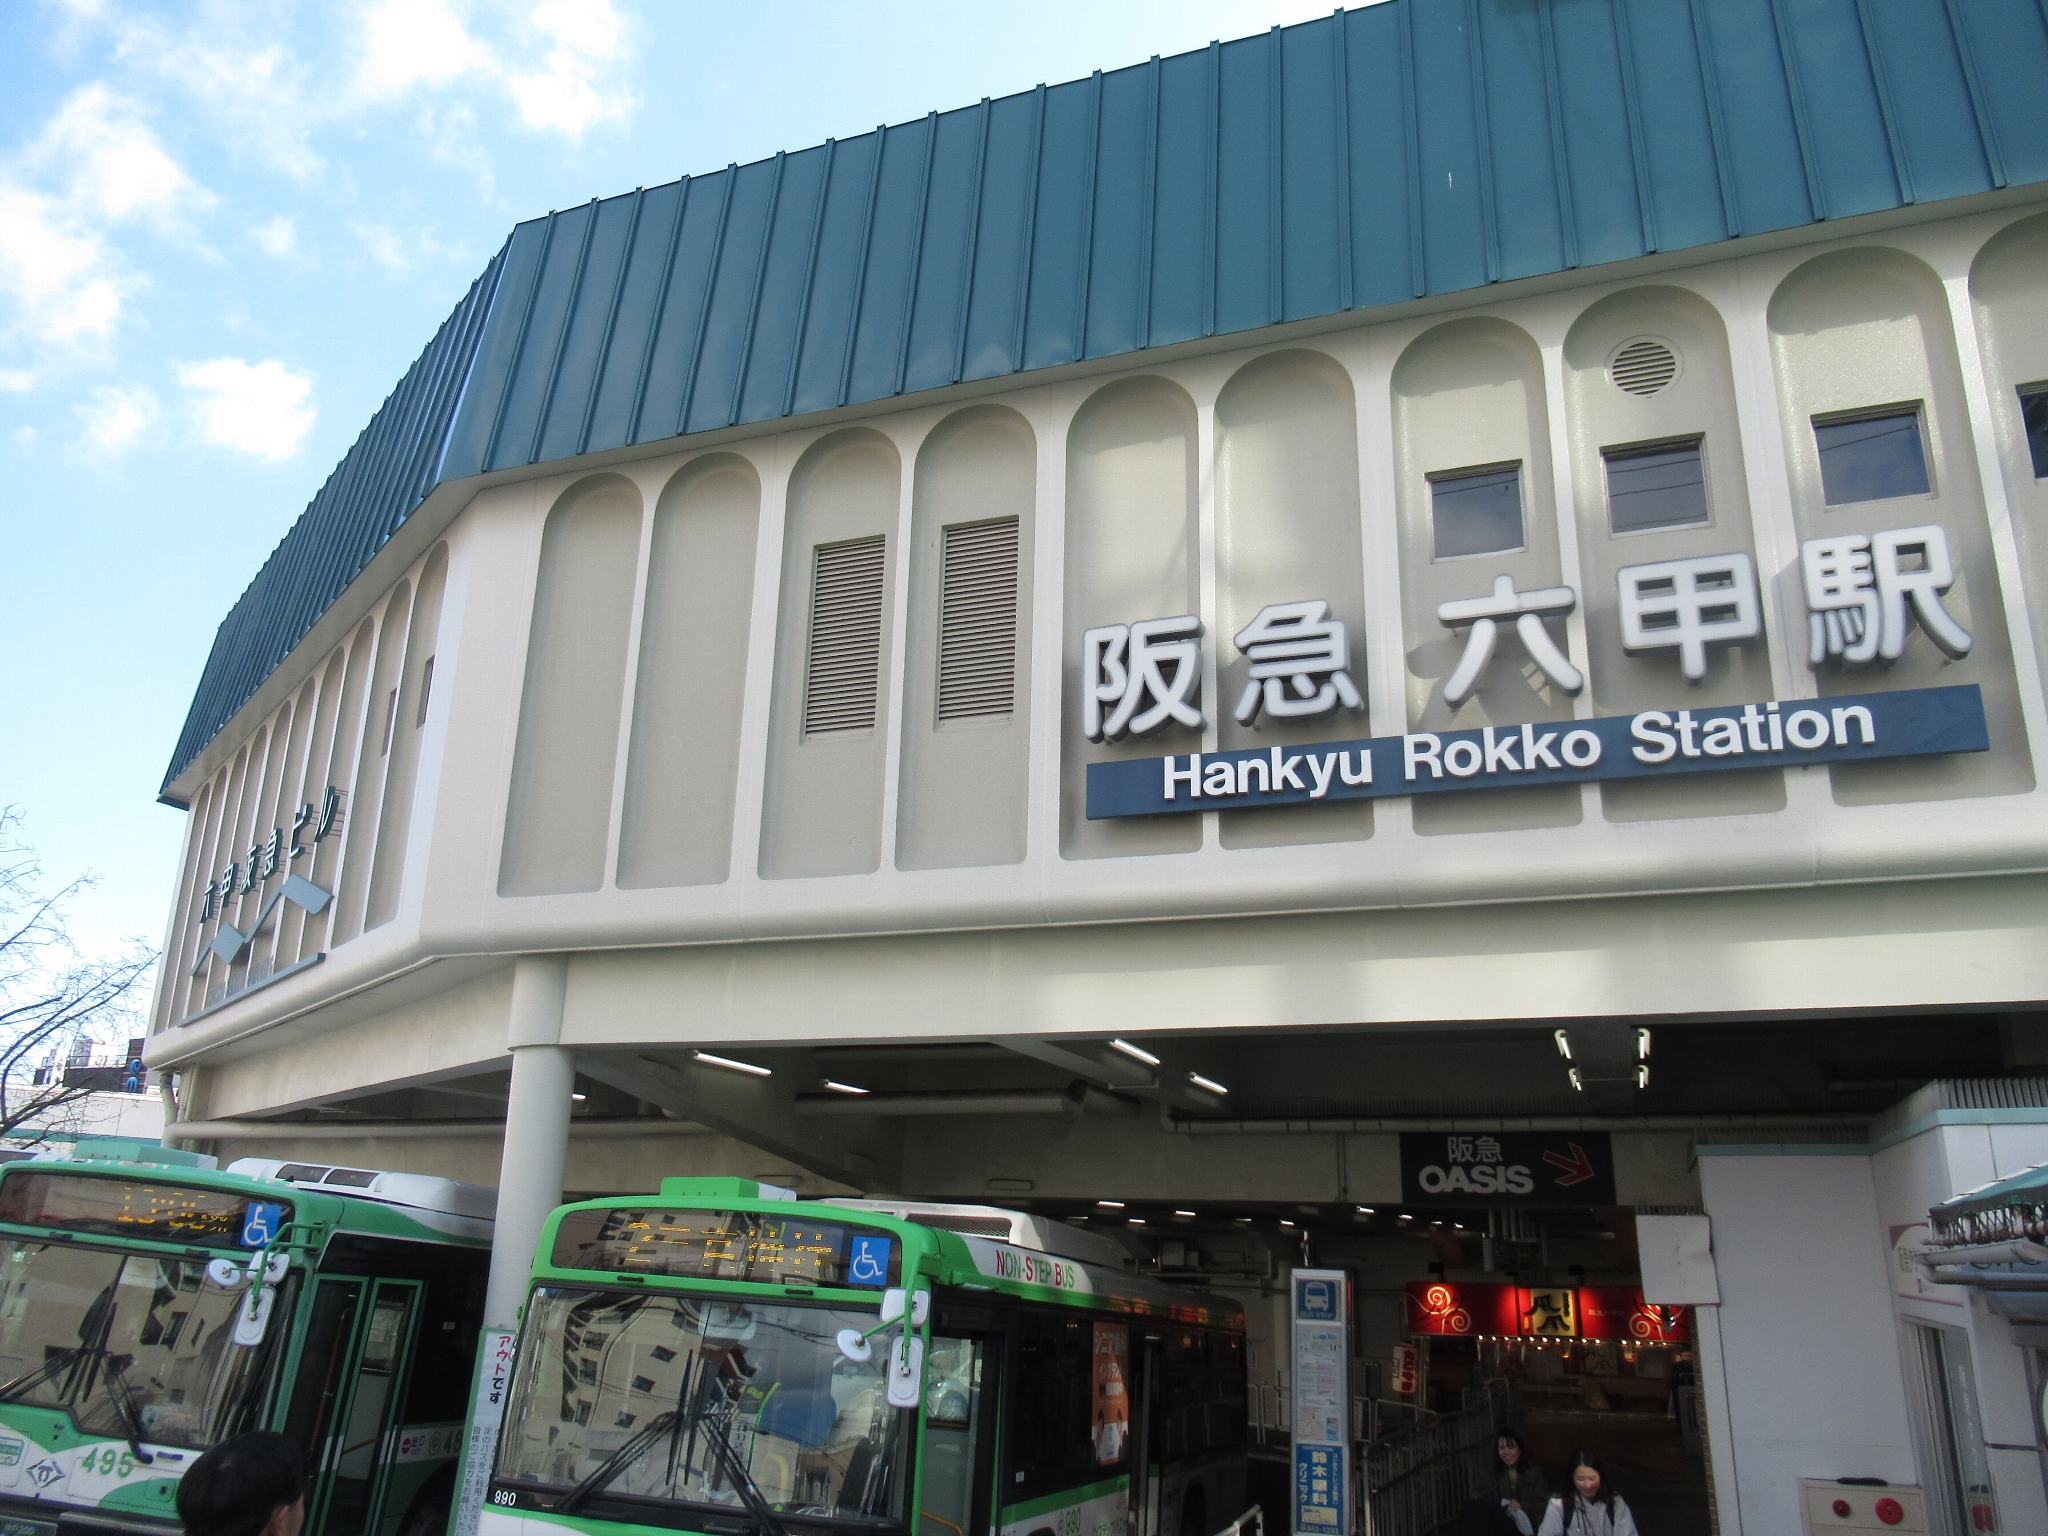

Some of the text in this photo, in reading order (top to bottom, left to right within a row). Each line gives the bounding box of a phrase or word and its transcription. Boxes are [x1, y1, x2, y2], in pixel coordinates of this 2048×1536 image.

[1083, 524, 1974, 743] 阪急六甲駅
[1163, 700, 1876, 802] Hankyu Rokko Station
[1447, 1135, 1503, 1164] 阪急
[1418, 1164, 1535, 1195] OASIS
[996, 1249, 1075, 1288] NON-STEP BUS
[1316, 1311, 1334, 1319] STOP
[489, 1334, 511, 1404] アウトです
[411, 1435, 426, 1448] 出口
[82, 1446, 134, 1479] 495
[1312, 1451, 1328, 1505] 鈴木眼科
[494, 1490, 517, 1506] 990
[1299, 1462, 1308, 1502] クリニック
[1065, 1506, 1081, 1534] 990
